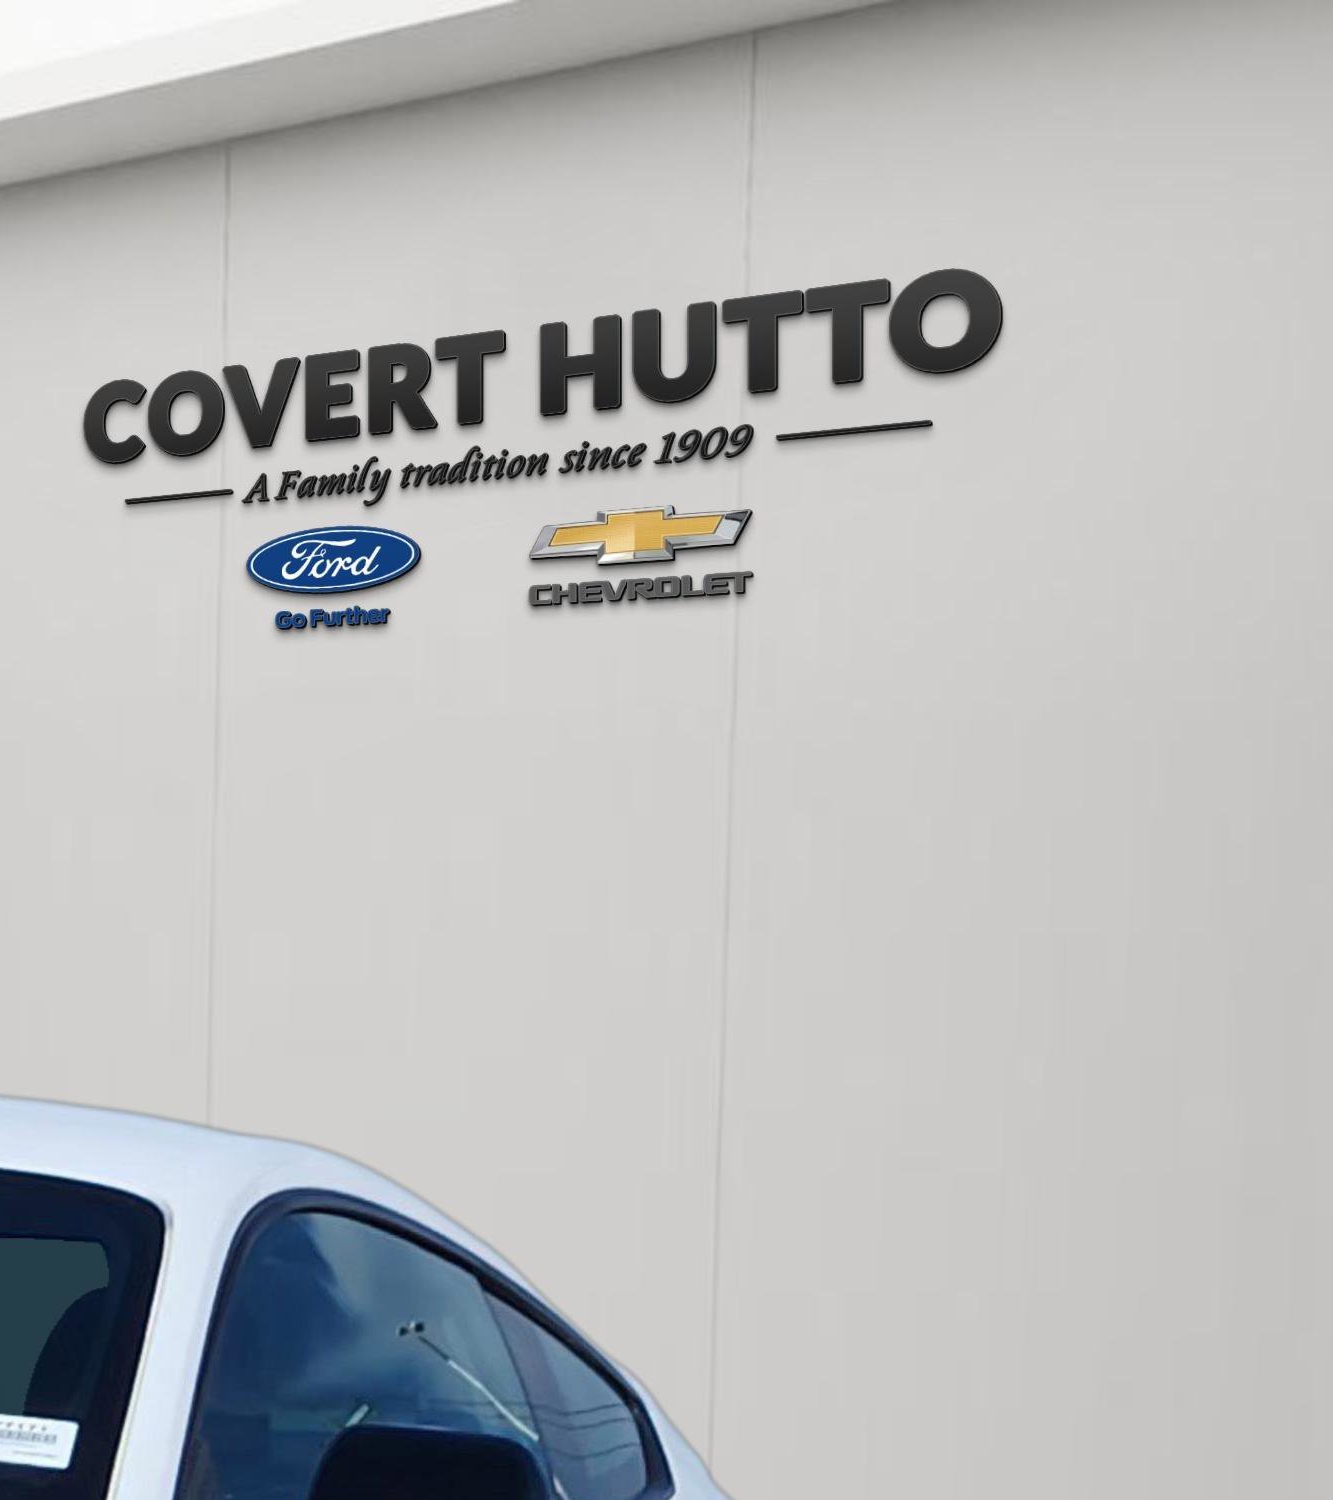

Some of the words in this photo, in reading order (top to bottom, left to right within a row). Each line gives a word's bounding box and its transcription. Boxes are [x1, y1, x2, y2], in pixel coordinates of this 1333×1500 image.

[83, 330, 507, 464] COVERT
[539, 268, 1003, 416] HUTTO
[242, 472, 270, 503] A
[274, 456, 391, 506] Family
[400, 445, 549, 489] tradition
[558, 440, 647, 474] since
[653, 424, 754, 465] 1909
[281, 538, 381, 581] Ford
[528, 571, 754, 607] CHEVROLET
[274, 610, 307, 631] Go
[309, 605, 391, 629] Further
